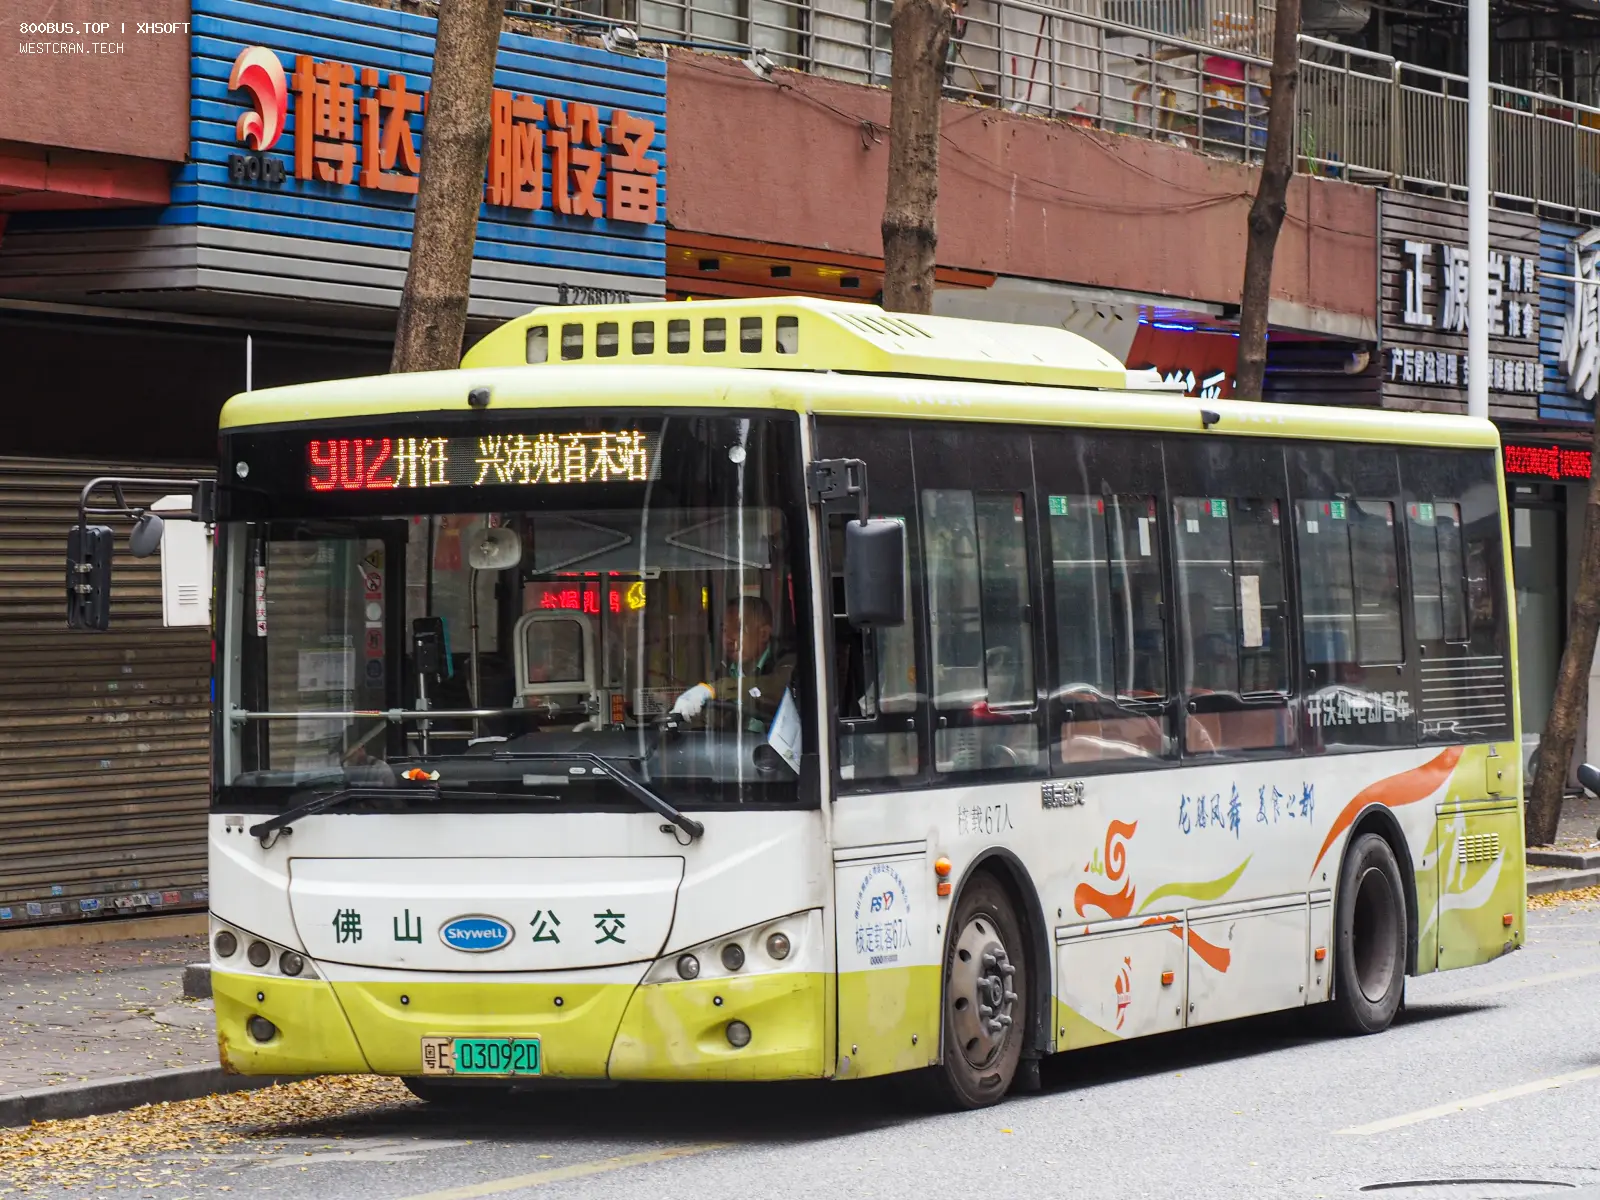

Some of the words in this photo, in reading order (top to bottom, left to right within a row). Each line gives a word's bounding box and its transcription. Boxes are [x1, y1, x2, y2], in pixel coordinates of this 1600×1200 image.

[291, 54, 658, 224] 博达脑设备
[311, 438, 392, 490] 902
[392, 437, 450, 487] 开往
[474, 430, 647, 486] 兴涛苑首末站
[957, 803, 1013, 835] 核载67人
[332, 908, 423, 944] 佛山
[529, 909, 626, 944] 公交
[447, 927, 505, 940] Skywell
[855, 918, 912, 955] 核定载客67人
